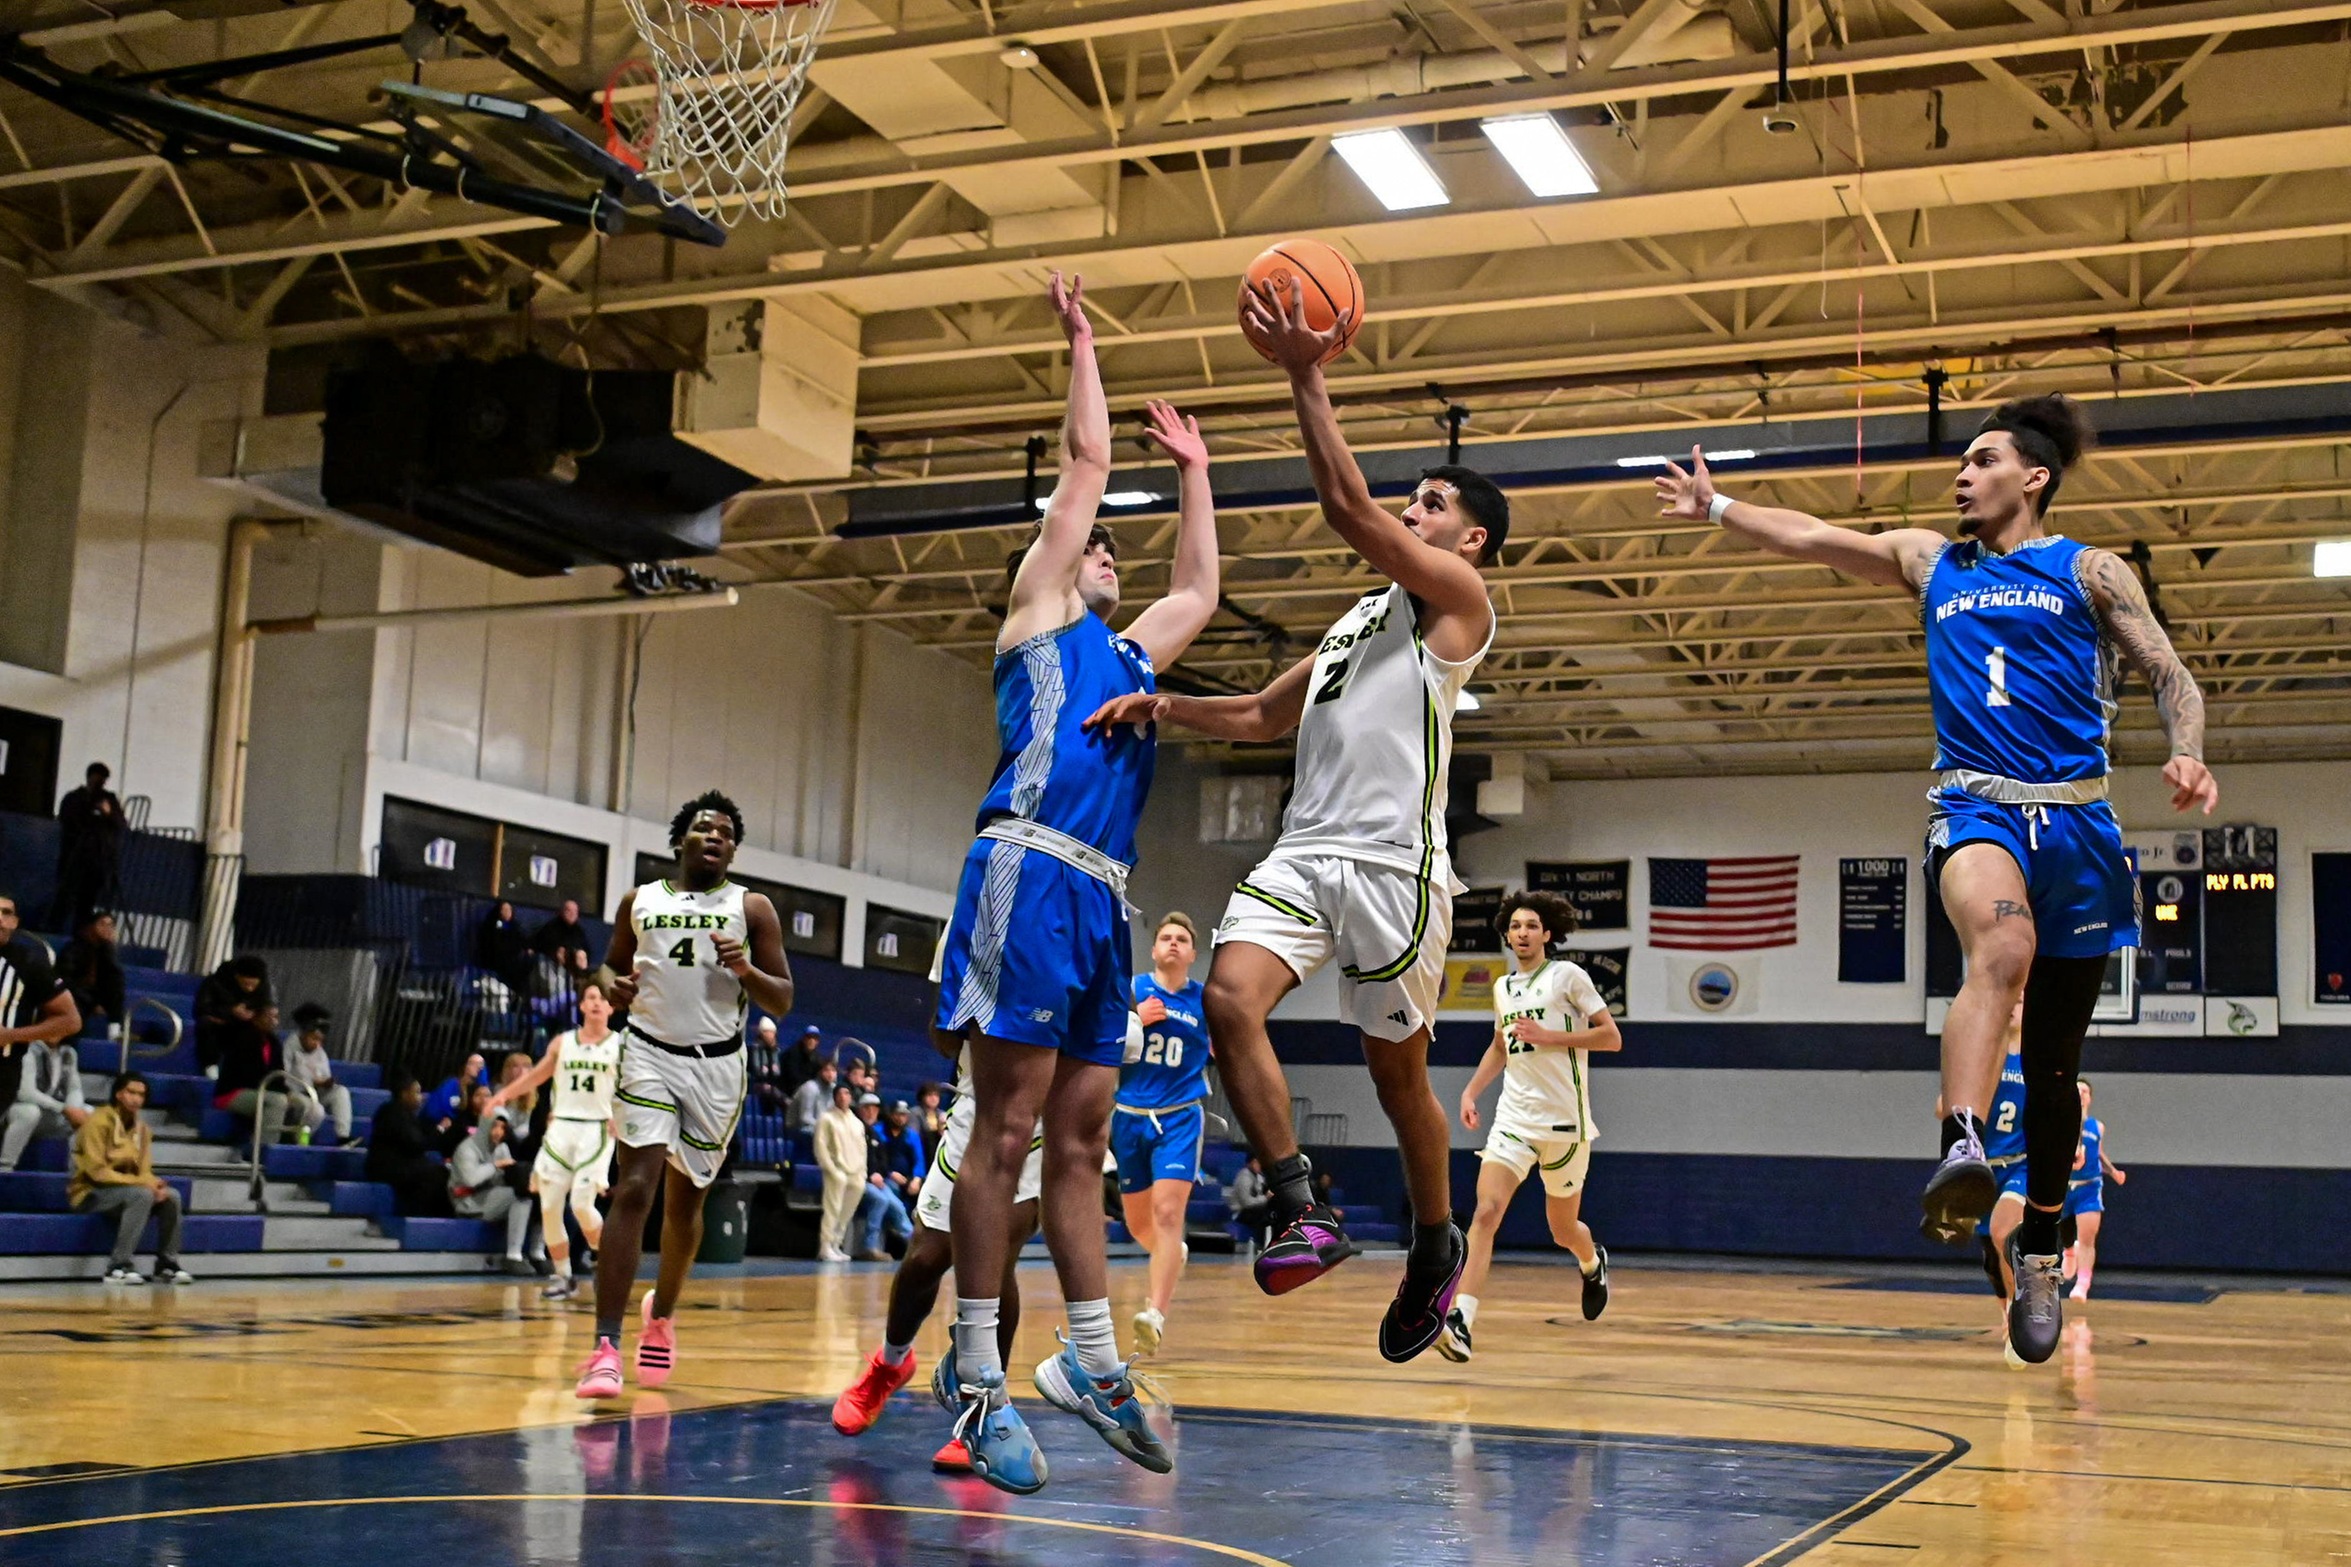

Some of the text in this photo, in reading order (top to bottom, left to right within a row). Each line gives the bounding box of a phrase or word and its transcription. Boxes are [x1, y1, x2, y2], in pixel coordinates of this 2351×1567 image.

[1952, 584, 2047, 599] UNIVERSITY OF
[1936, 590, 2064, 623] NEW ENGLAND
[1313, 657, 1349, 705] 2
[1985, 646, 2012, 707] 1
[1575, 870, 1615, 882] NORTH
[1858, 860, 1890, 874] 1000
[2250, 873, 2275, 890] PTS
[643, 914, 729, 931] LESLEY
[2073, 925, 2088, 935] NEW
[668, 937, 695, 967] 4
[1145, 1032, 1184, 1068] 20
[564, 1061, 609, 1073] LESLEY
[571, 1074, 595, 1093] 14
[1995, 1100, 2017, 1133] 2
